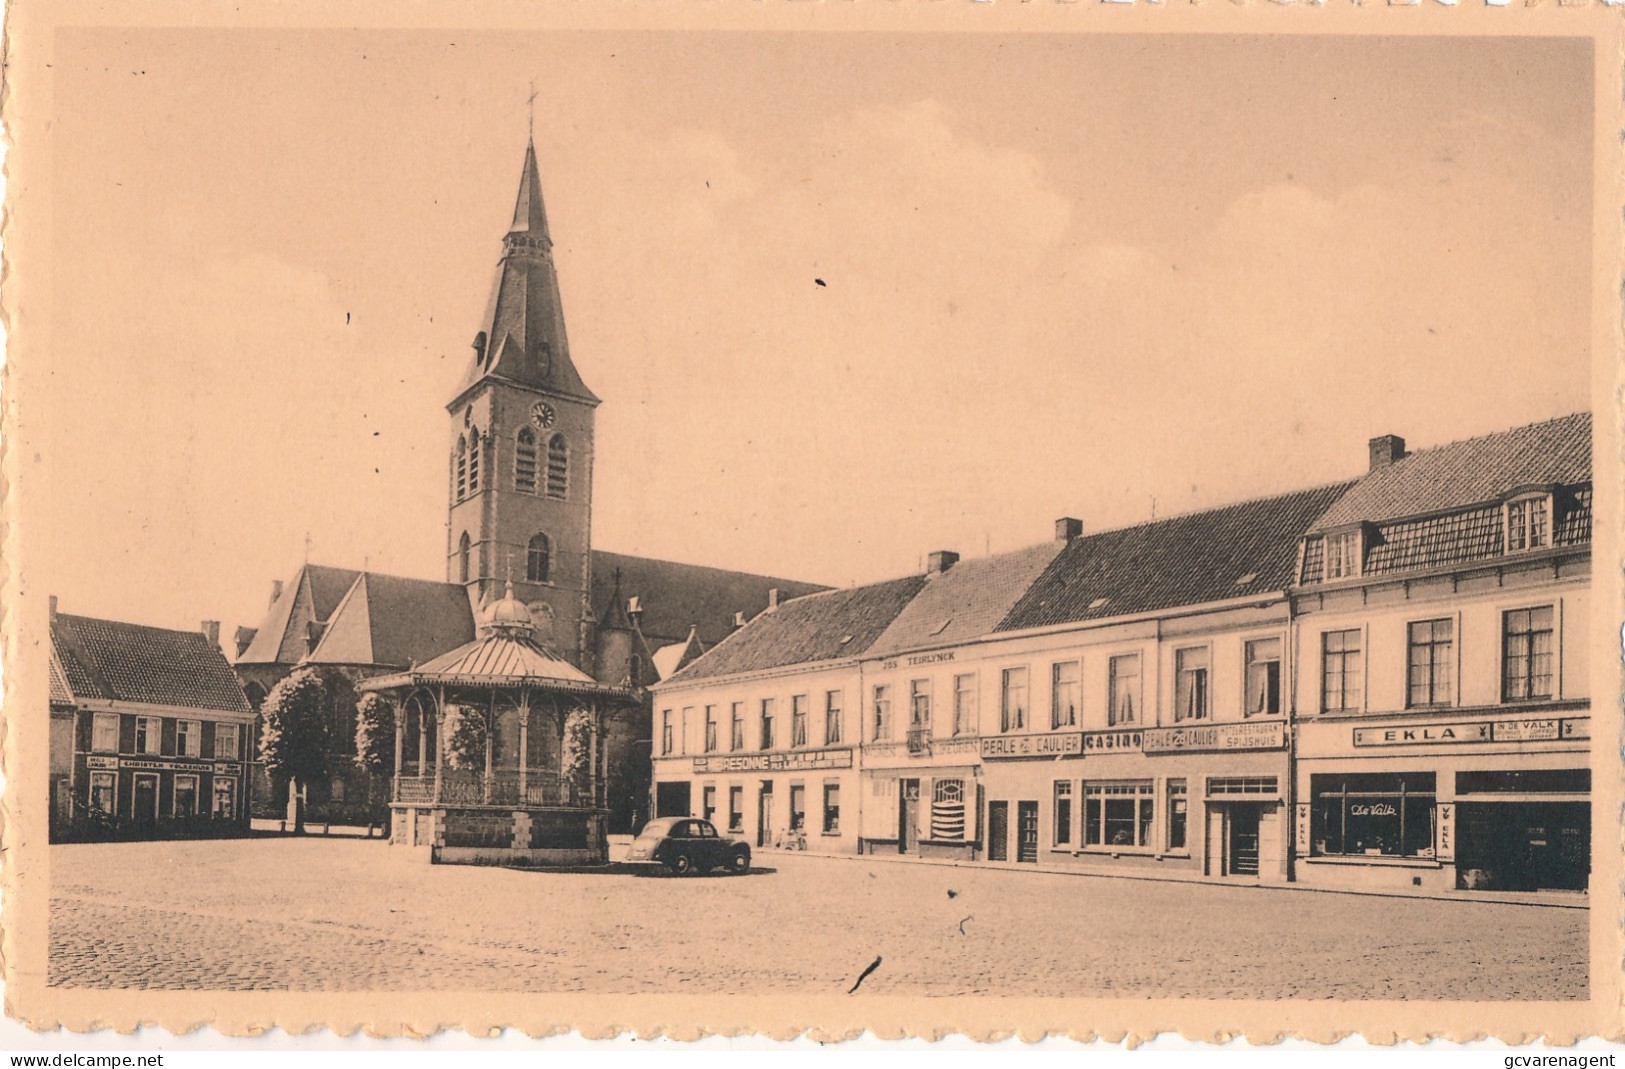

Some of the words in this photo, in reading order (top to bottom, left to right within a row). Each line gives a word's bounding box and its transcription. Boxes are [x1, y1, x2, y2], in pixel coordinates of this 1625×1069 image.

[882, 661, 898, 670] JOS
[908, 652, 955, 666] TEIRLYNCK
[1523, 721, 1554, 729] VALK
[1085, 733, 1142, 749] CASINO
[1145, 732, 1171, 748] PERLE
[1174, 733, 1185, 744] 28
[1188, 730, 1217, 746] CAULIER
[1226, 736, 1276, 747] SPIJSHUIS
[1384, 728, 1456, 742] EKLA
[983, 739, 1016, 755] PERLE
[1036, 736, 1078, 752] CAULIER
